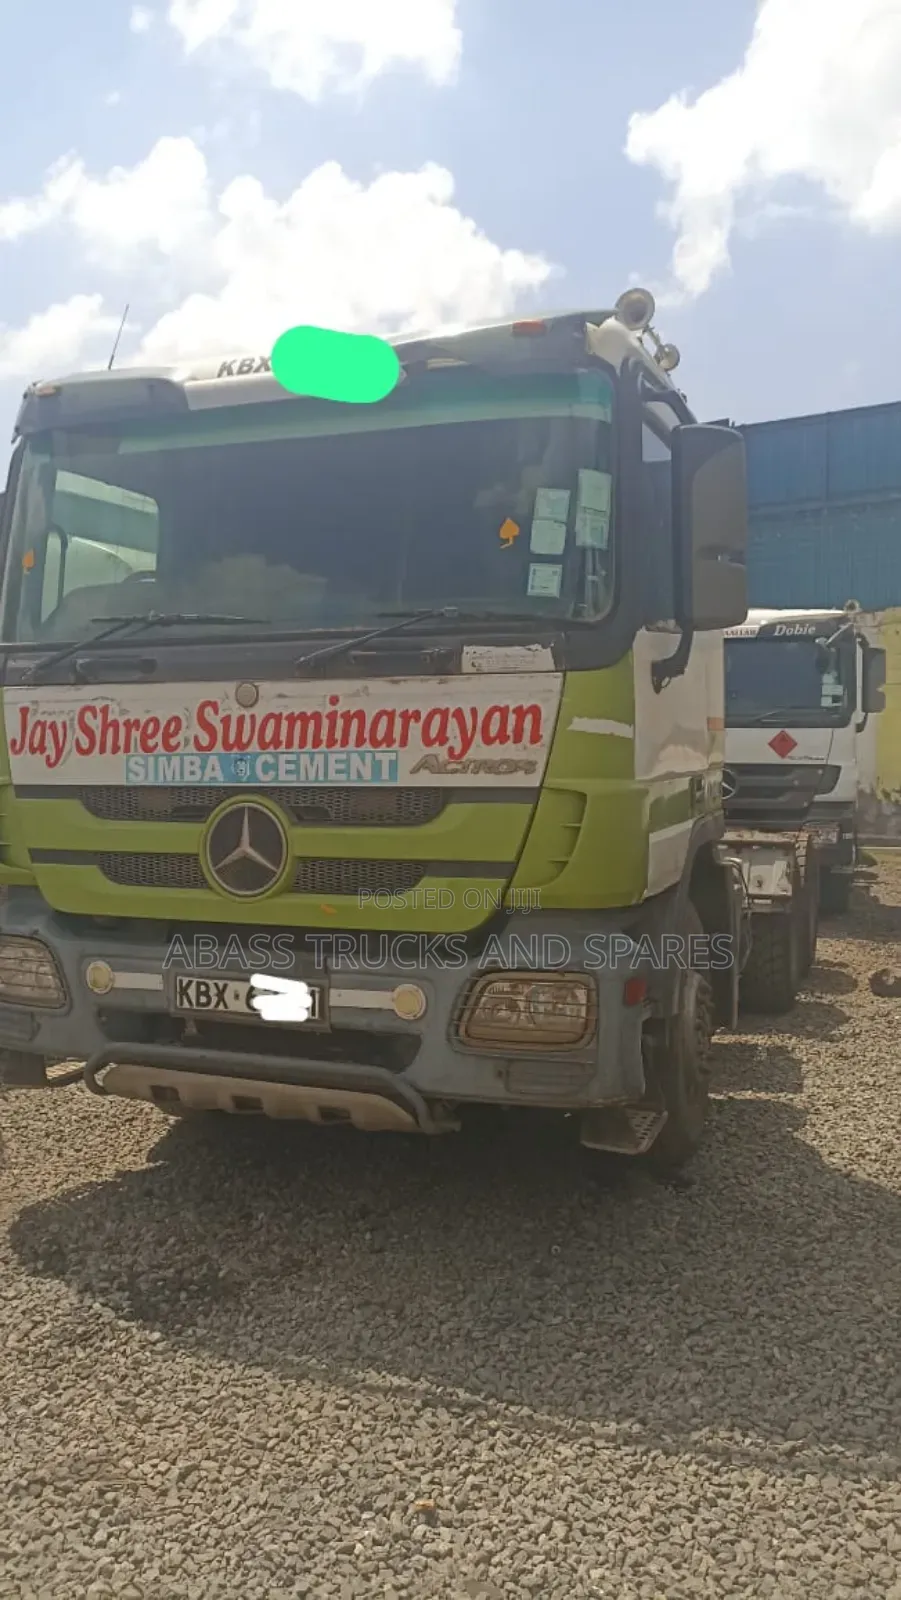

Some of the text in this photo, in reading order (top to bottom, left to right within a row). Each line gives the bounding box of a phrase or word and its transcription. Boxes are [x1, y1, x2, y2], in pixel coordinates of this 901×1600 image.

[216, 355, 272, 379] KBX
[773, 623, 816, 637] Dobie
[10, 694, 544, 769] Jay Shree Swaminarayan
[127, 752, 397, 783] SIMBA CEMENT
[177, 978, 230, 1010] KBX
